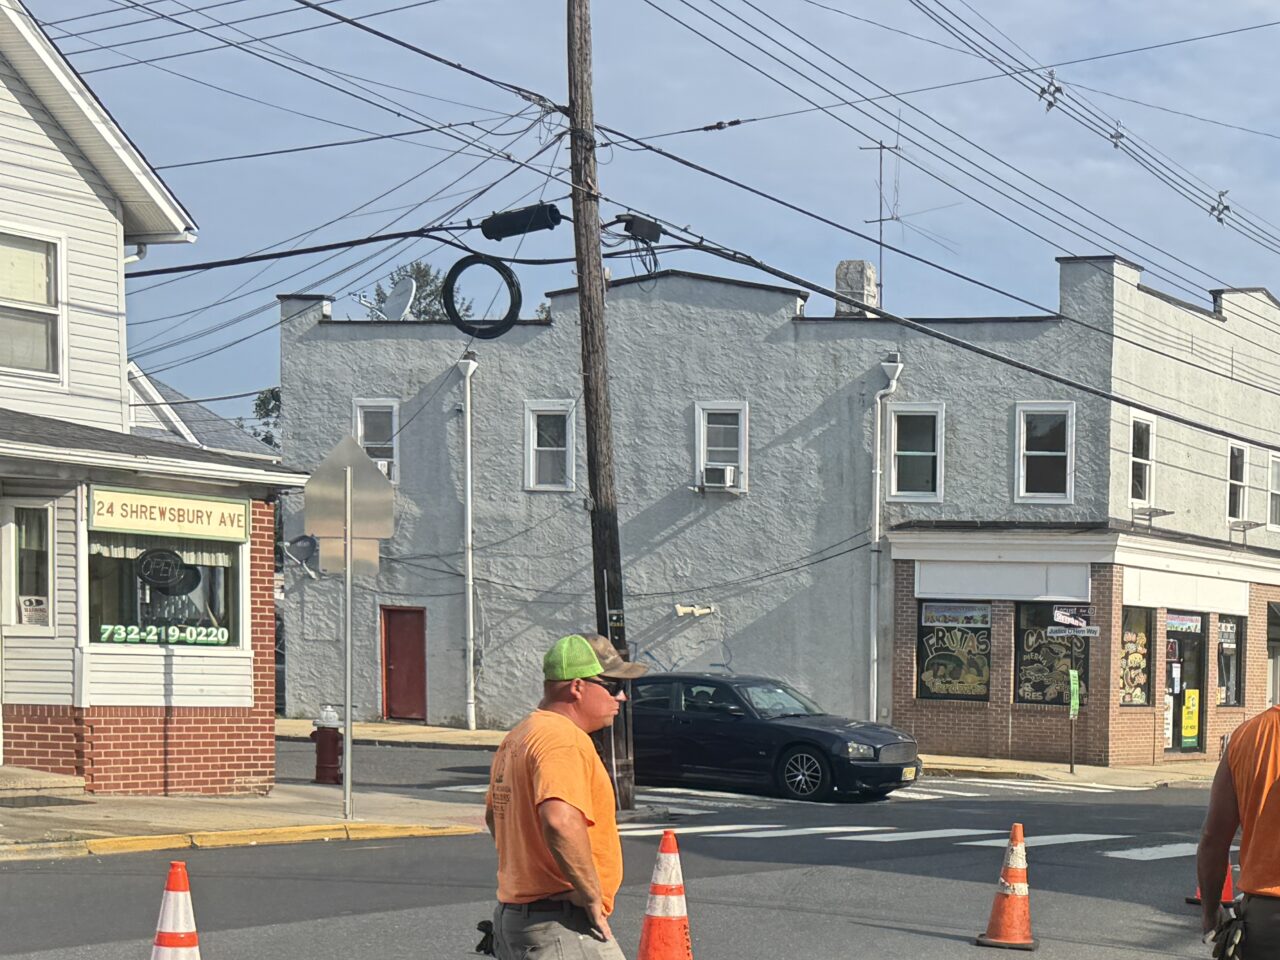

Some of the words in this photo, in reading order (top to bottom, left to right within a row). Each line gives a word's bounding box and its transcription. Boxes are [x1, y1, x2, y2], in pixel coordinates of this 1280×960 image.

[120, 503, 213, 526] SHREWSBURY
[218, 512, 245, 529] AVE
[100, 624, 230, 646] 732-219-0220
[923, 626, 991, 658] FRUTAS
[1024, 691, 1044, 701] RES
